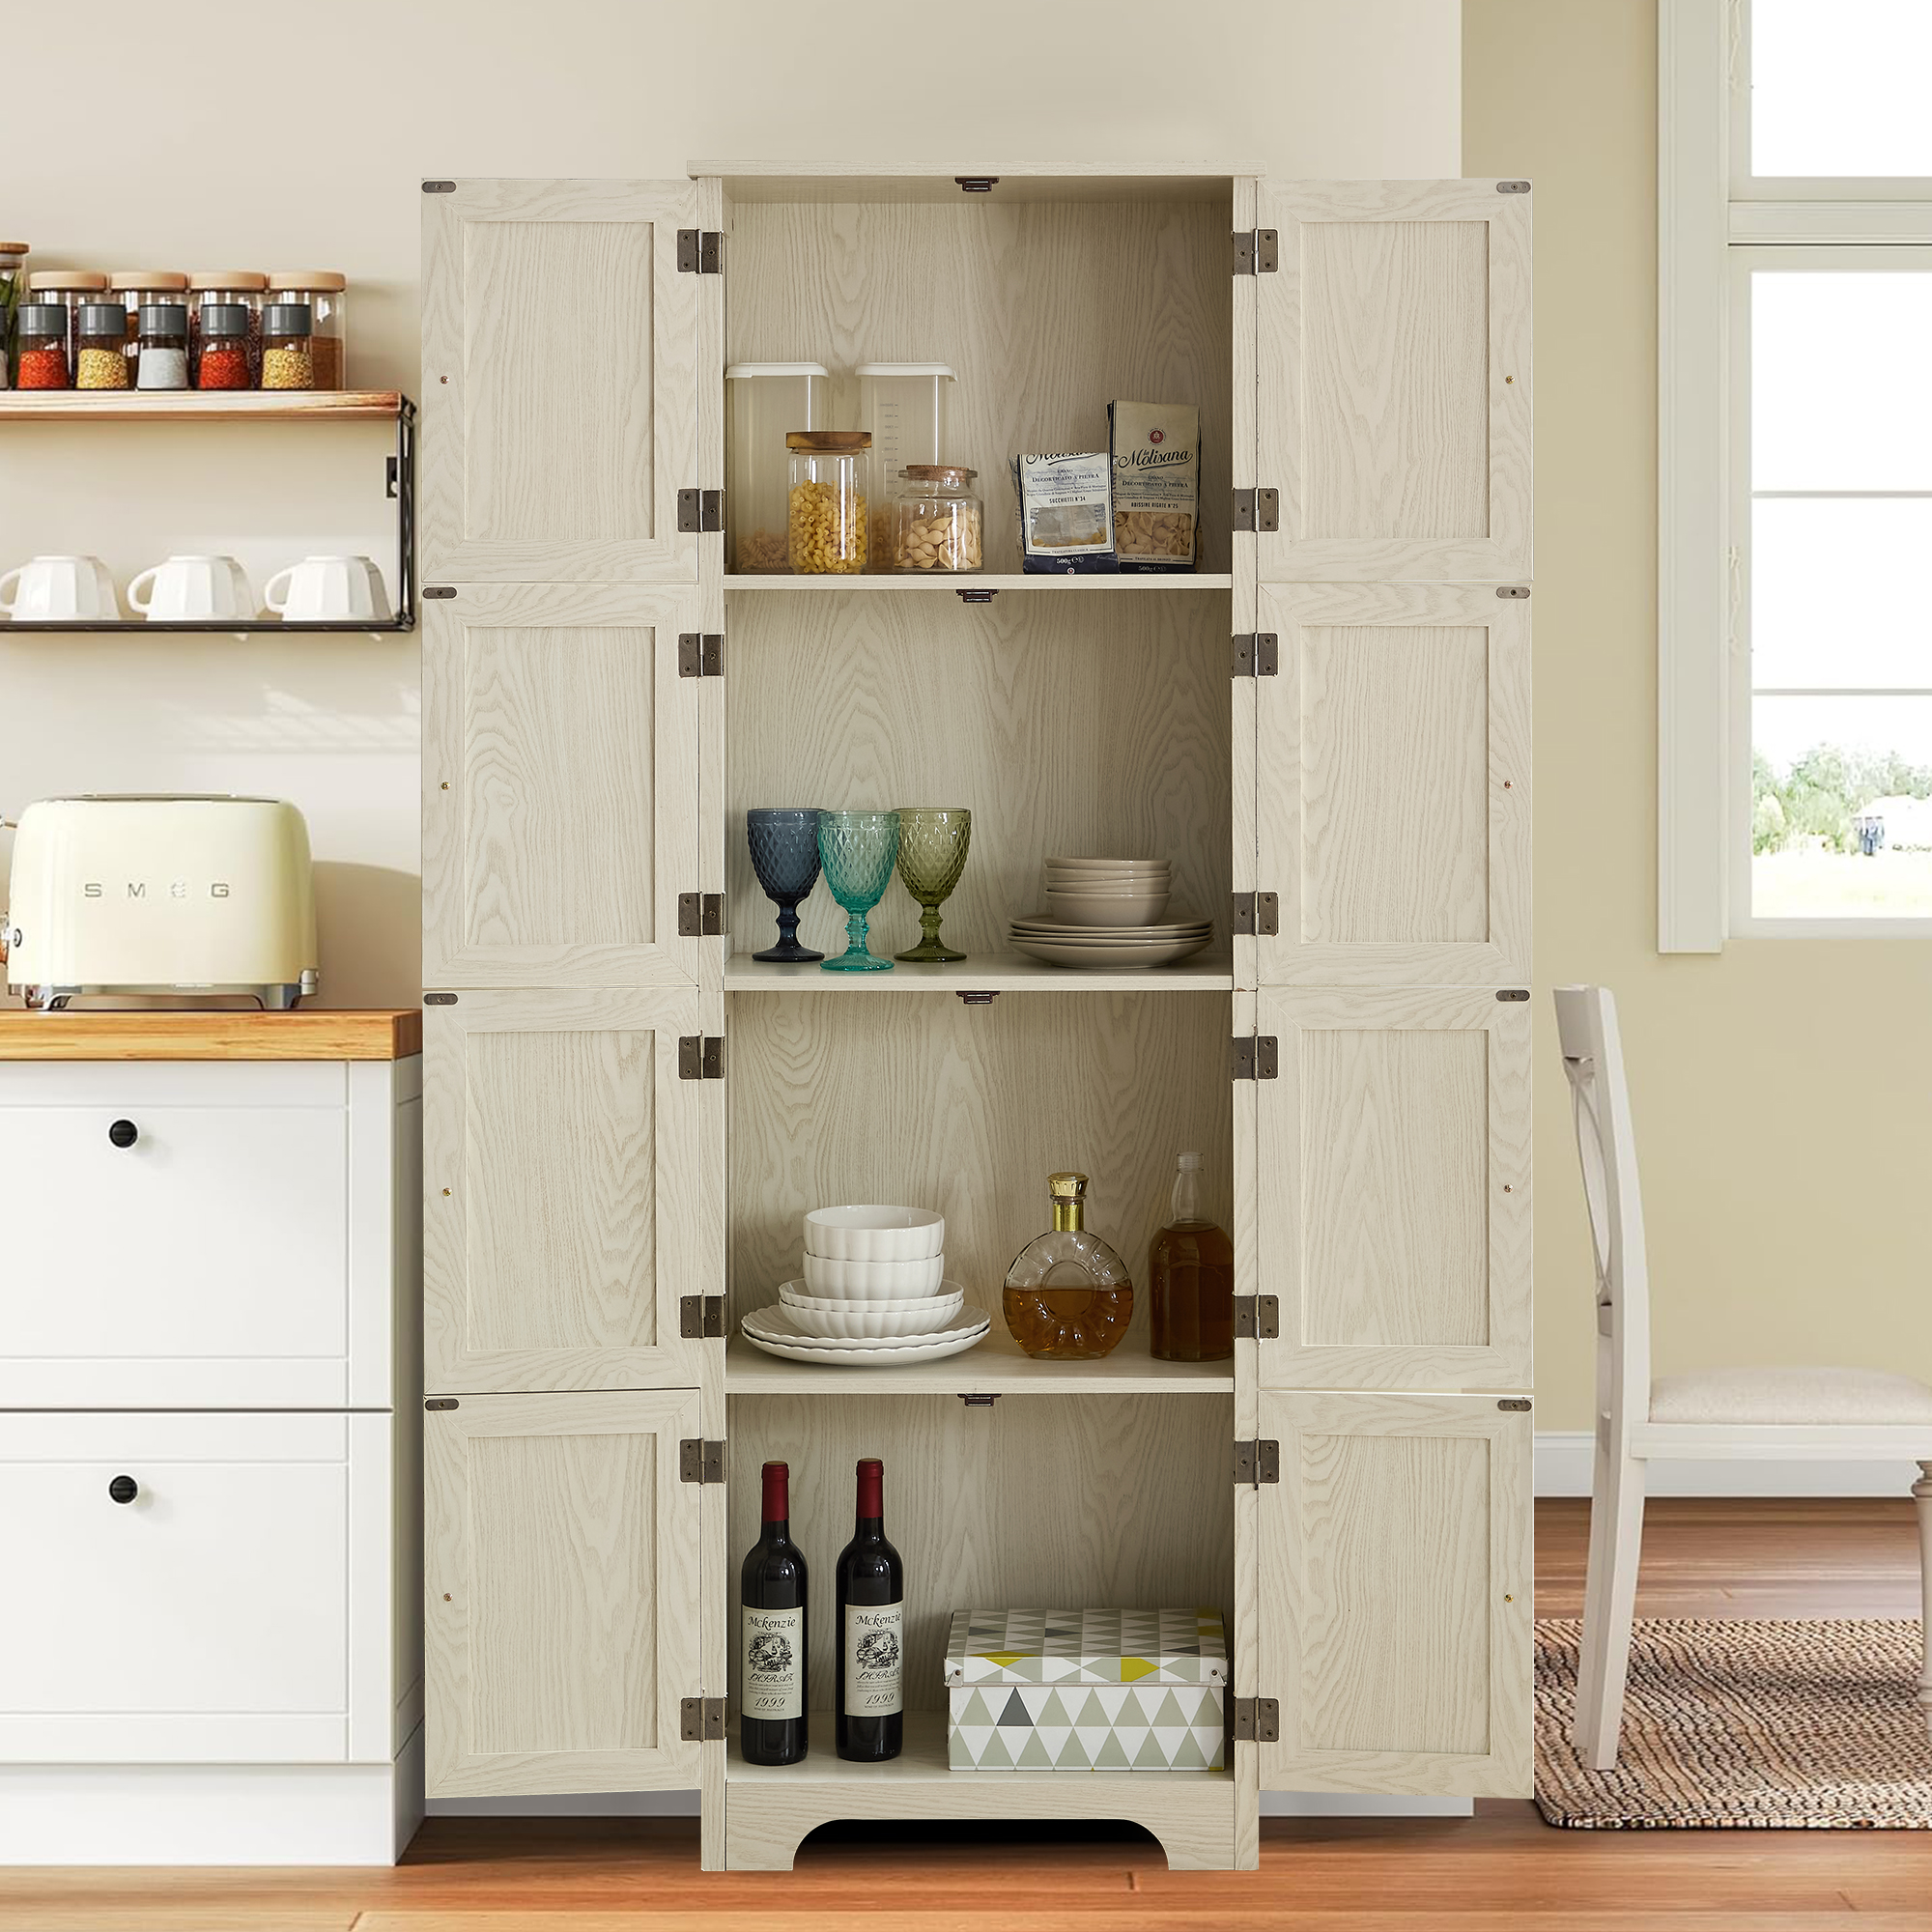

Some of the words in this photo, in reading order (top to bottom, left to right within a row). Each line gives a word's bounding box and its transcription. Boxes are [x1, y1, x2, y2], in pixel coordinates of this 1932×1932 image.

[1119, 448, 1193, 468] Molisana
[1056, 556, 1071, 565] 500g
[748, 1616, 796, 1631] Mckenzie
[855, 1610, 900, 1628] Mckenzie
[755, 1696, 785, 1707] 1999
[866, 1692, 895, 1705] 1999
